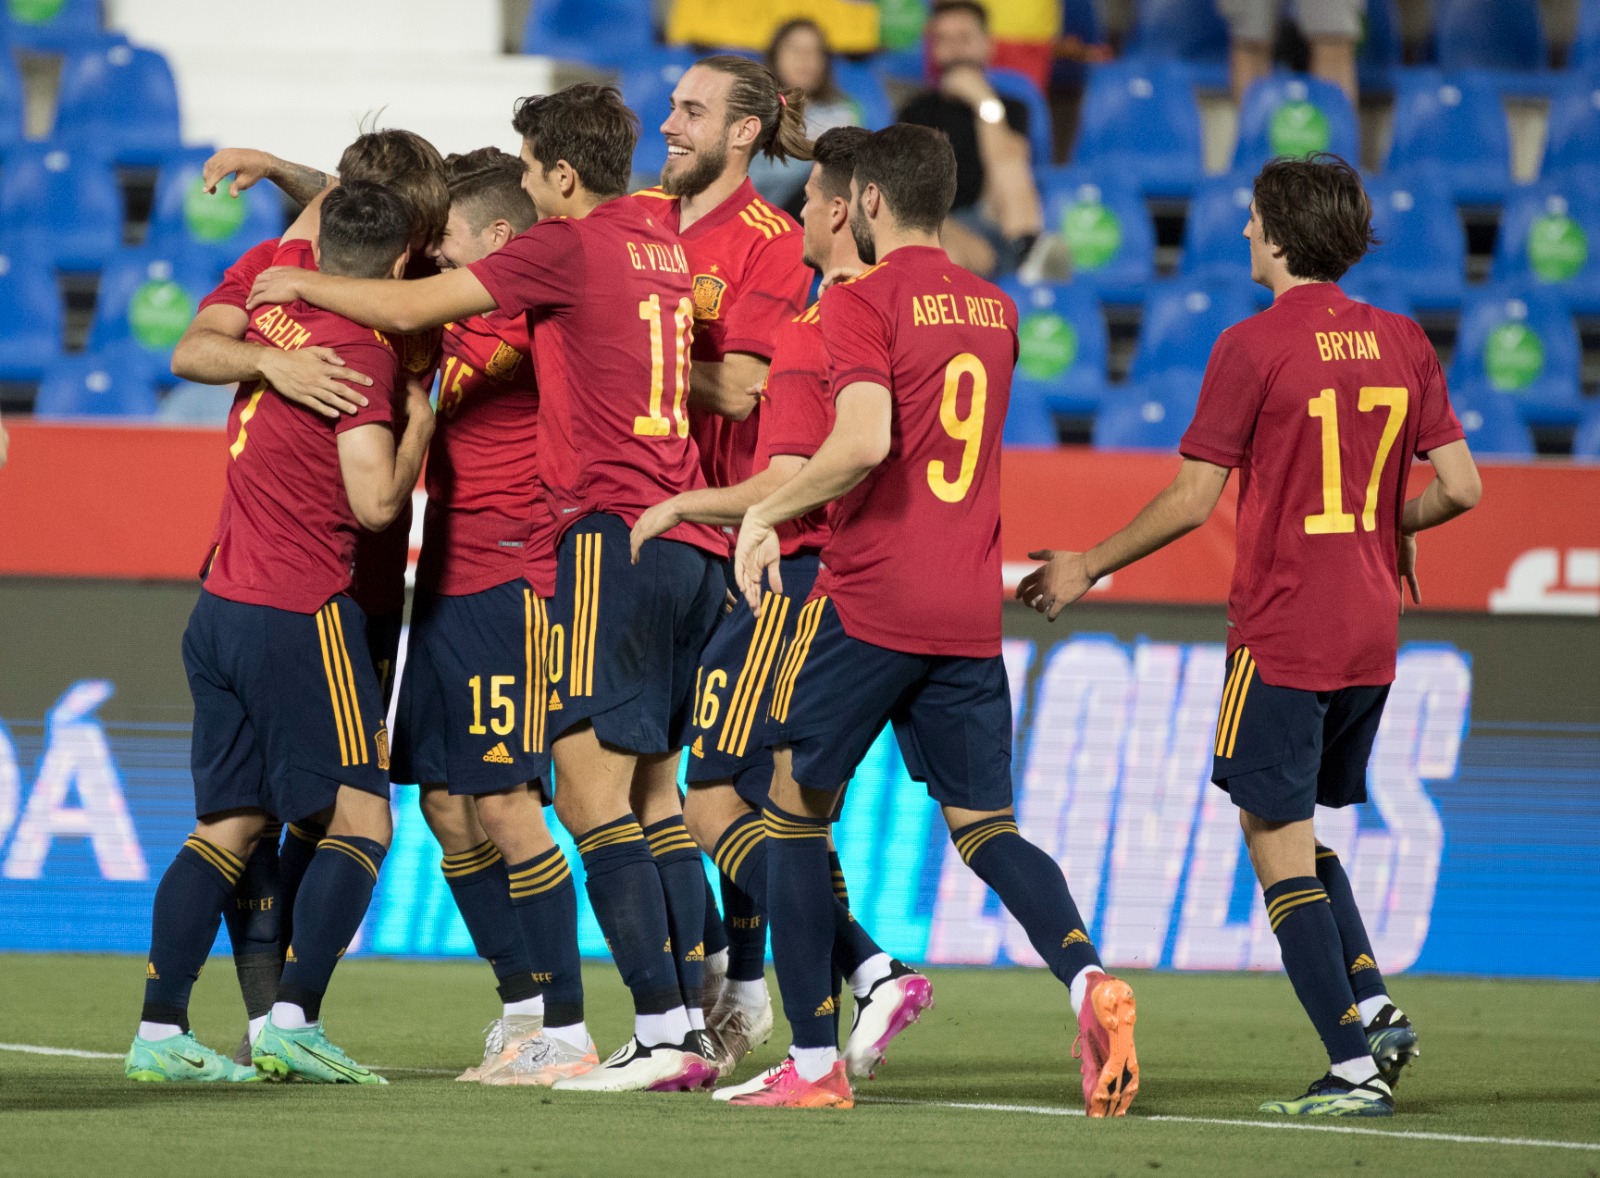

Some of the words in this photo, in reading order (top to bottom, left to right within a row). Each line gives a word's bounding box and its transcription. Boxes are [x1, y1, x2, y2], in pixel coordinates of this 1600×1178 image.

[626, 241, 646, 270] G.
[912, 293, 965, 327] ABEL
[964, 295, 1008, 330] RUIZ
[634, 294, 694, 439] 10
[1315, 331, 1380, 361] BRYAN
[438, 356, 474, 418] 15
[927, 352, 988, 503] 9
[1304, 386, 1409, 535] 17
[468, 675, 516, 736] 15
[482, 754, 514, 764] adidas
